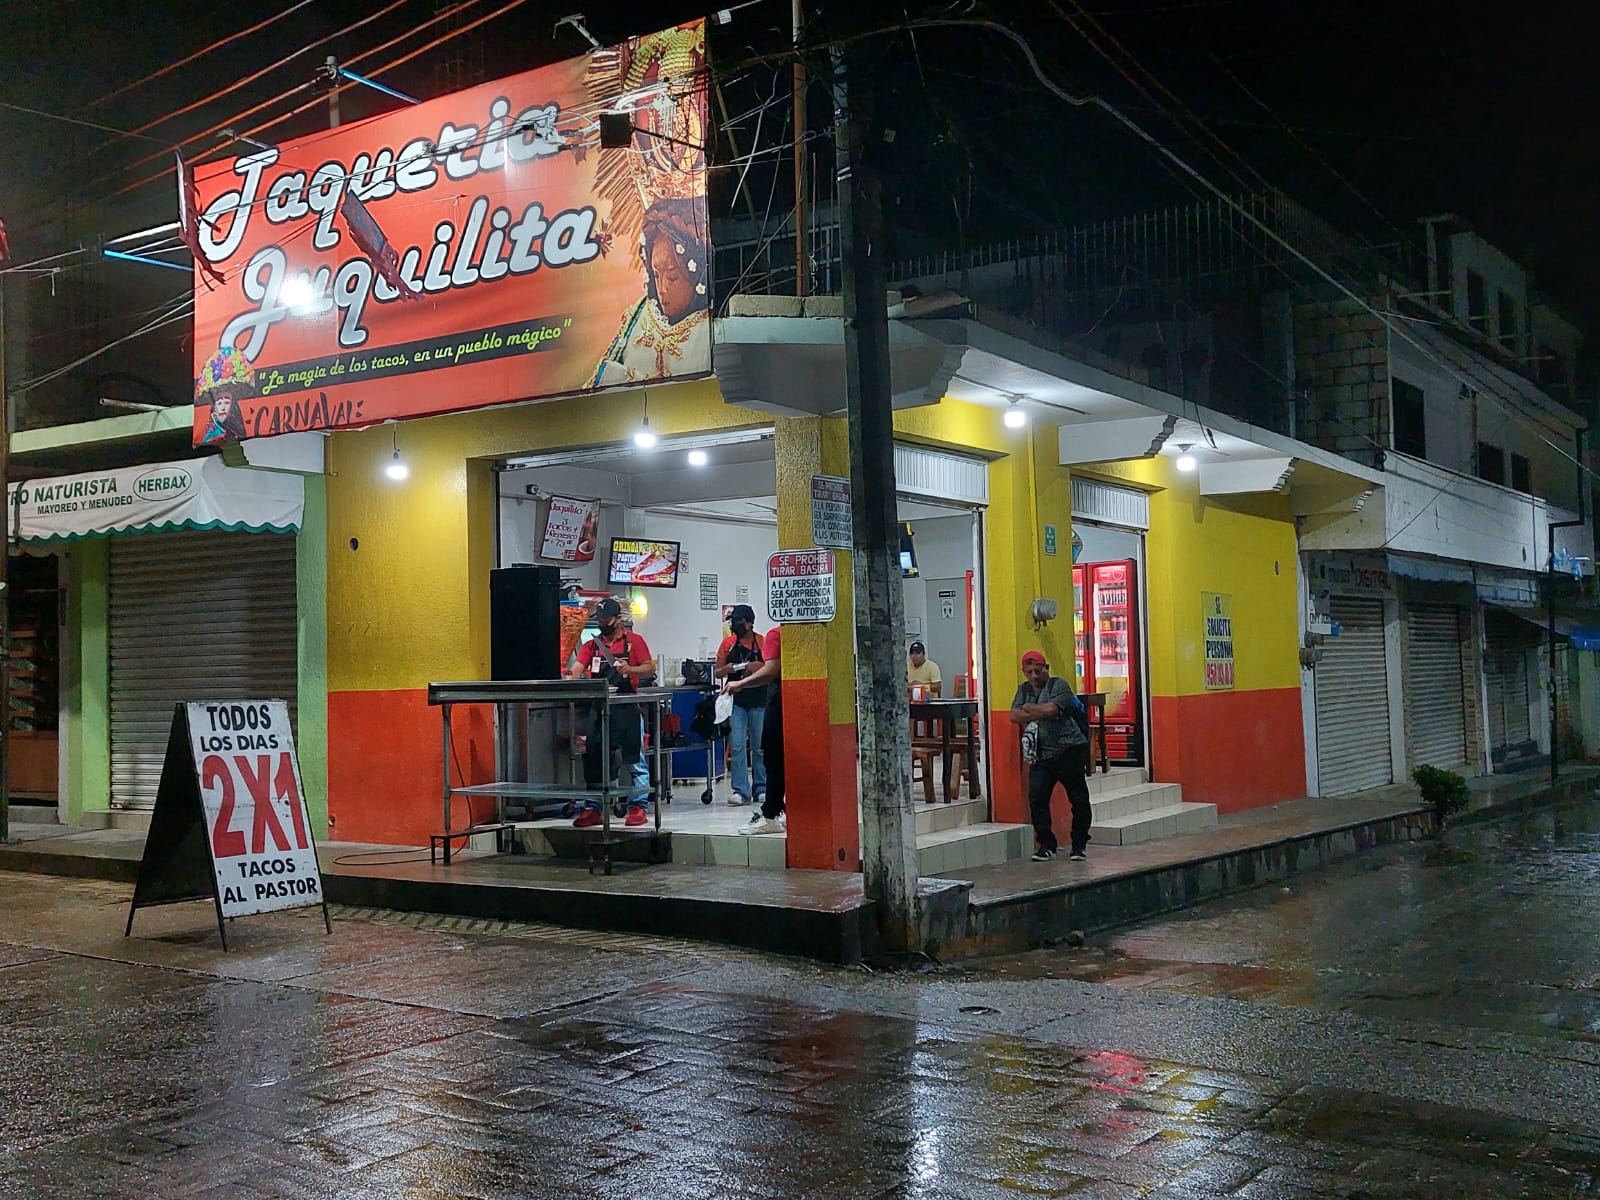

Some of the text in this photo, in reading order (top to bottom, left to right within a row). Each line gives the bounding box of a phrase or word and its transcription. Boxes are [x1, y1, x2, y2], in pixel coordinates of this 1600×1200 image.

[219, 195, 600, 362] Juquilita
[288, 368, 326, 387] magia
[330, 359, 345, 376] de
[349, 357, 368, 373] los
[371, 352, 409, 369] tacos,
[414, 350, 431, 362] en
[434, 346, 453, 358] un
[454, 331, 502, 363] pueblo
[34, 477, 118, 503] NATURISTA
[138, 474, 187, 493] HERBAX
[37, 495, 133, 515] MAYOREO Y MENUDEO
[771, 563, 829, 576] TIRAR BASURA
[779, 555, 790, 566] SE
[771, 576, 832, 589] A LA PERSON QUE
[770, 599, 789, 608] SERA
[771, 590, 783, 599] SEA
[772, 609, 777, 618] A
[780, 608, 793, 618] LAS
[206, 704, 272, 732] TODOS
[200, 734, 279, 752] LOS DIAS
[202, 752, 309, 858] 2X1
[238, 857, 296, 878] TACOS
[223, 877, 318, 905] AL PASTOR
